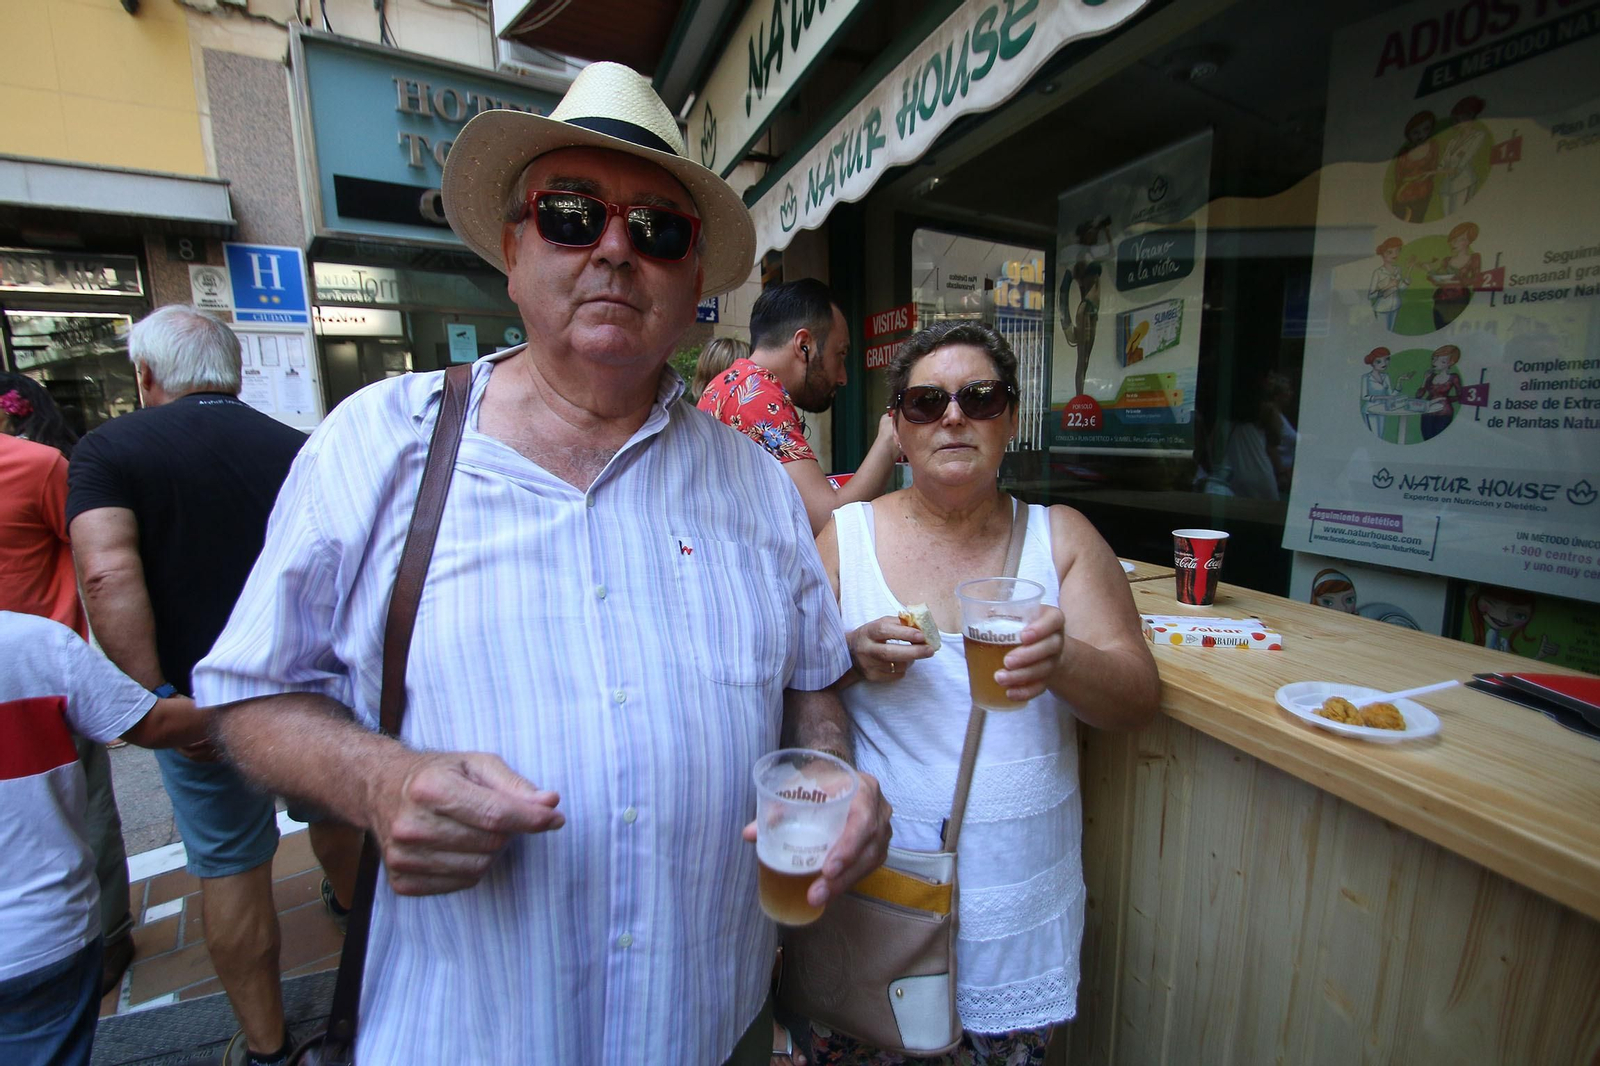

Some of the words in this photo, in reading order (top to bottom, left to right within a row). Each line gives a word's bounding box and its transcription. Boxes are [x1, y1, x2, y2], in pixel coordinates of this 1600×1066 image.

[1431, 60, 1456, 87] EL
[805, 106, 886, 215] NATUR
[896, 0, 1038, 140] HOUSE
[178, 238, 195, 261] 8
[1131, 237, 1176, 262] Verano
[246, 251, 286, 291] H
[1127, 272, 1135, 284] a
[1137, 259, 1150, 281] la
[1152, 256, 1181, 277] vista
[1508, 266, 1573, 287] Semanal
[1503, 292, 1517, 305] tu
[1519, 288, 1570, 303] Asesor
[872, 306, 909, 336] VISITAS
[1492, 399, 1501, 410] a
[1505, 397, 1538, 410] base
[1541, 397, 1560, 410] de
[1487, 416, 1504, 428] de
[1507, 416, 1560, 429] Plantas
[1399, 473, 1471, 495] NATUR
[1478, 477, 1561, 501] HOUSE
[1403, 492, 1439, 504] Expertos
[1441, 496, 1452, 504] en
[1454, 496, 1494, 508] Nutrición
[1504, 500, 1548, 513] Dietética
[1312, 509, 1360, 524] seguimiento
[1362, 514, 1400, 528] dietético
[1323, 525, 1422, 546] www.naturhouse.com
[1516, 531, 1530, 541] UN
[1531, 532, 1570, 546] MÉTODO
[1502, 543, 1542, 558] +1.900
[1545, 549, 1593, 565] centros
[1523, 560, 1531, 571] y
[1533, 562, 1554, 573] uno
[1556, 564, 1581, 579] muy
[967, 625, 1017, 643] Mahou
